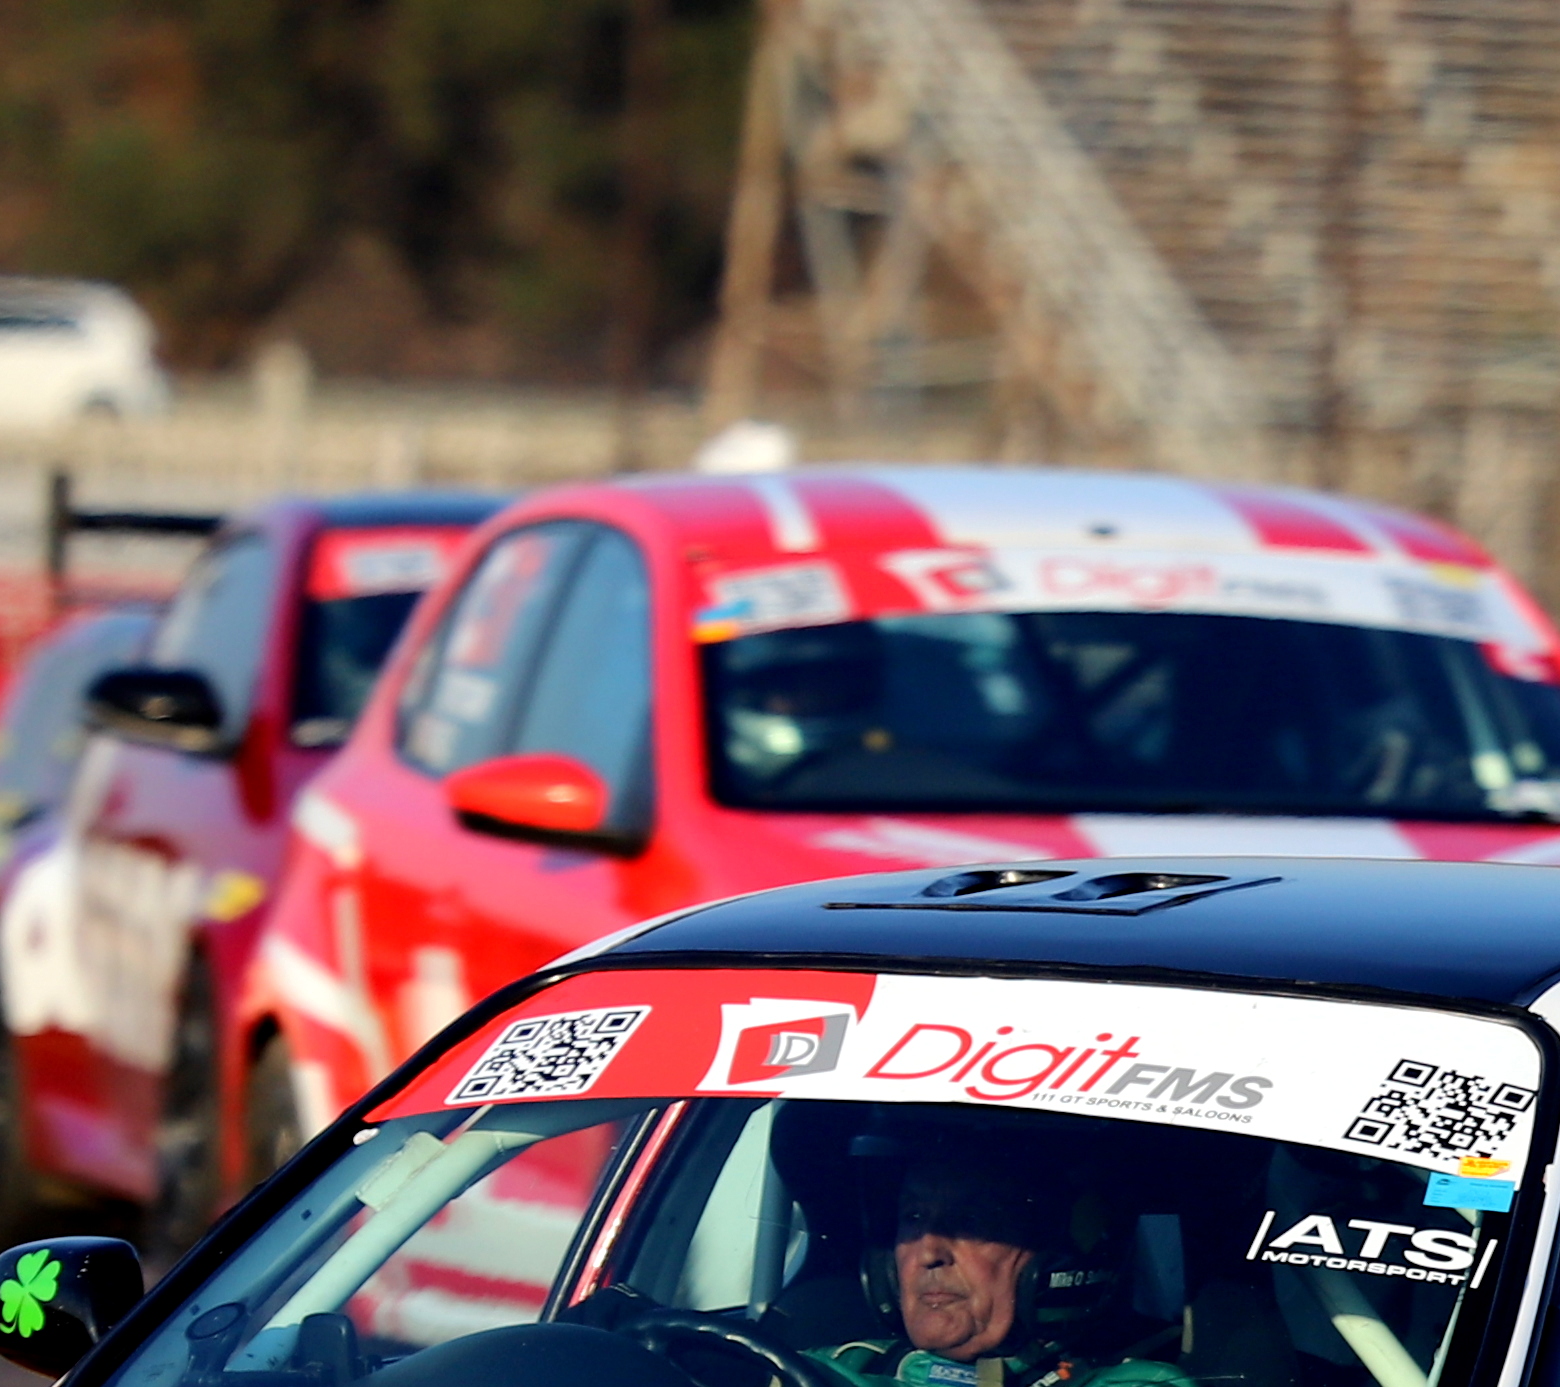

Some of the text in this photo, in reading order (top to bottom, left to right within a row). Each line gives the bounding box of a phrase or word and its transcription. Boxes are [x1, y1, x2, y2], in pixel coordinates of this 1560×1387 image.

[863, 1023, 1274, 1110] DigitFMS
[1058, 1095, 1083, 1106] GT
[1085, 1096, 1151, 1113] SPORTS
[1155, 1103, 1169, 1114] &
[1172, 1105, 1254, 1124] SALOONS
[1268, 1213, 1478, 1271] ATS
[1261, 1250, 1467, 1287] MOTORSPORT
